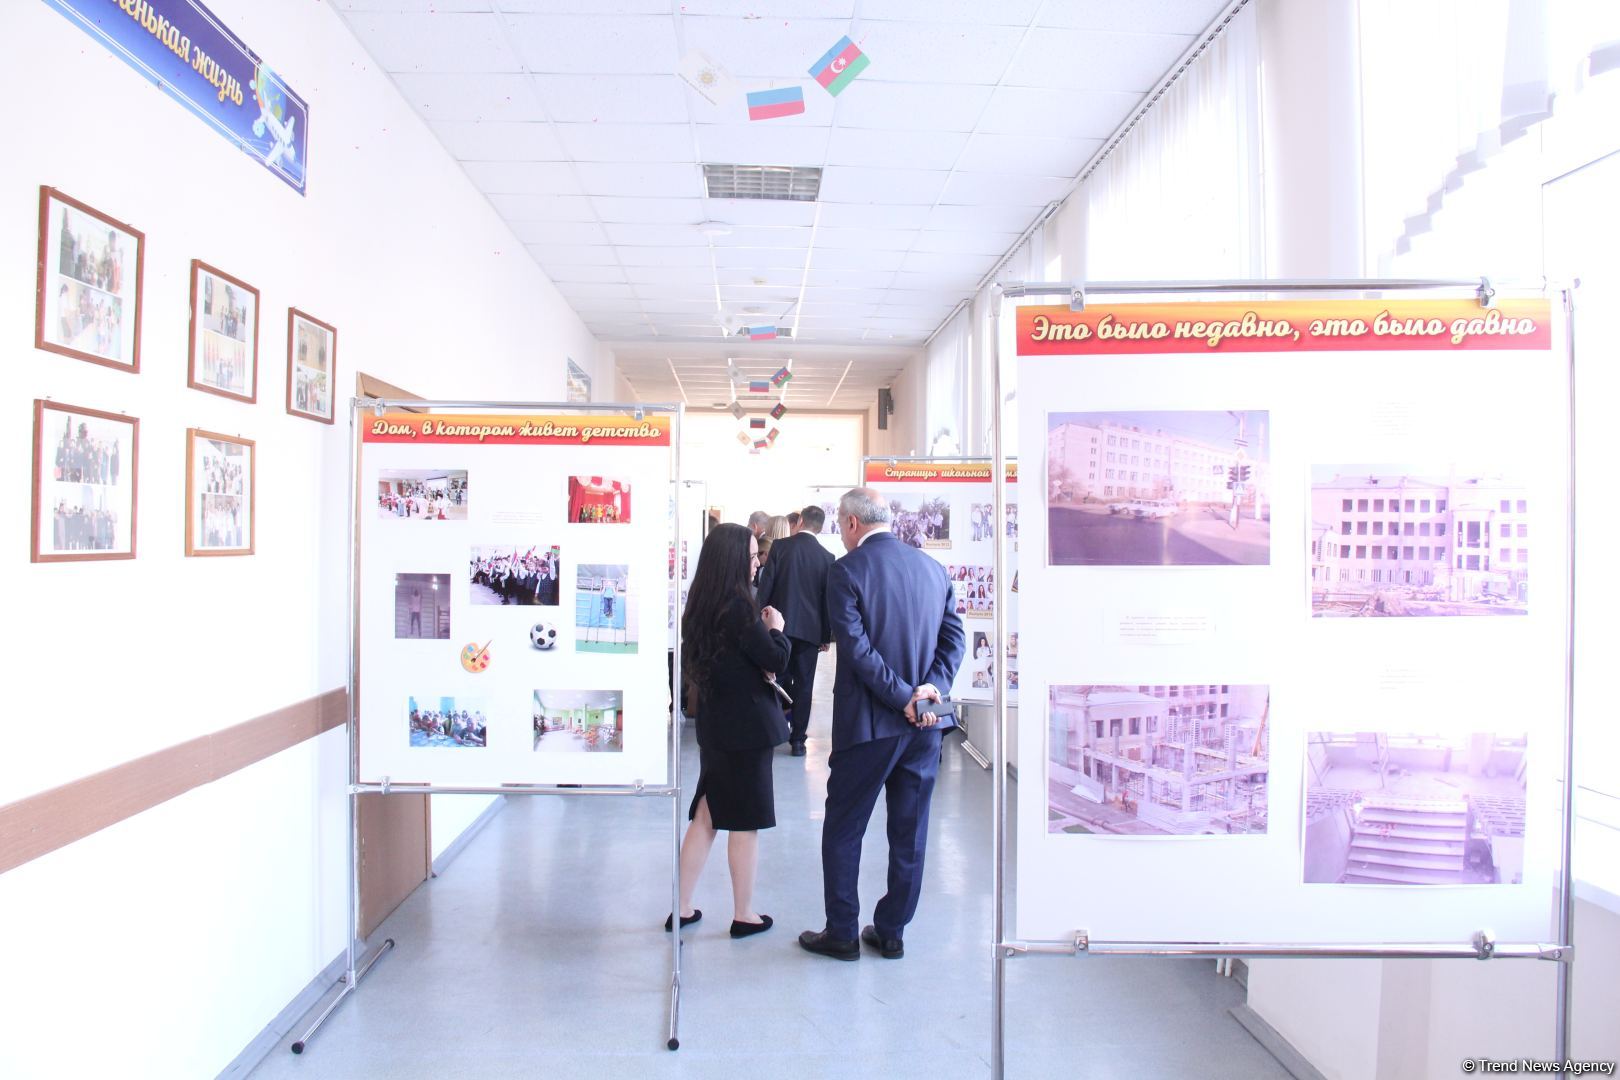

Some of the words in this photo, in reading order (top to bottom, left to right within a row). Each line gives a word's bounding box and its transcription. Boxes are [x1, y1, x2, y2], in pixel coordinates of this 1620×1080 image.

[191, 46, 243, 106] жизнь
[1031, 315, 1093, 341] Это
[1097, 313, 1170, 340] было
[1174, 311, 1300, 348] недавно,
[1309, 318, 1369, 336] это
[1373, 309, 1446, 336] было
[1450, 309, 1537, 345] давно
[371, 419, 416, 438] Дом,
[422, 420, 433, 435] в
[436, 420, 516, 442] котором
[519, 420, 579, 437] живет
[581, 422, 662, 442] детство
[884, 467, 938, 480] Страницы
[941, 467, 991, 478] школьной
